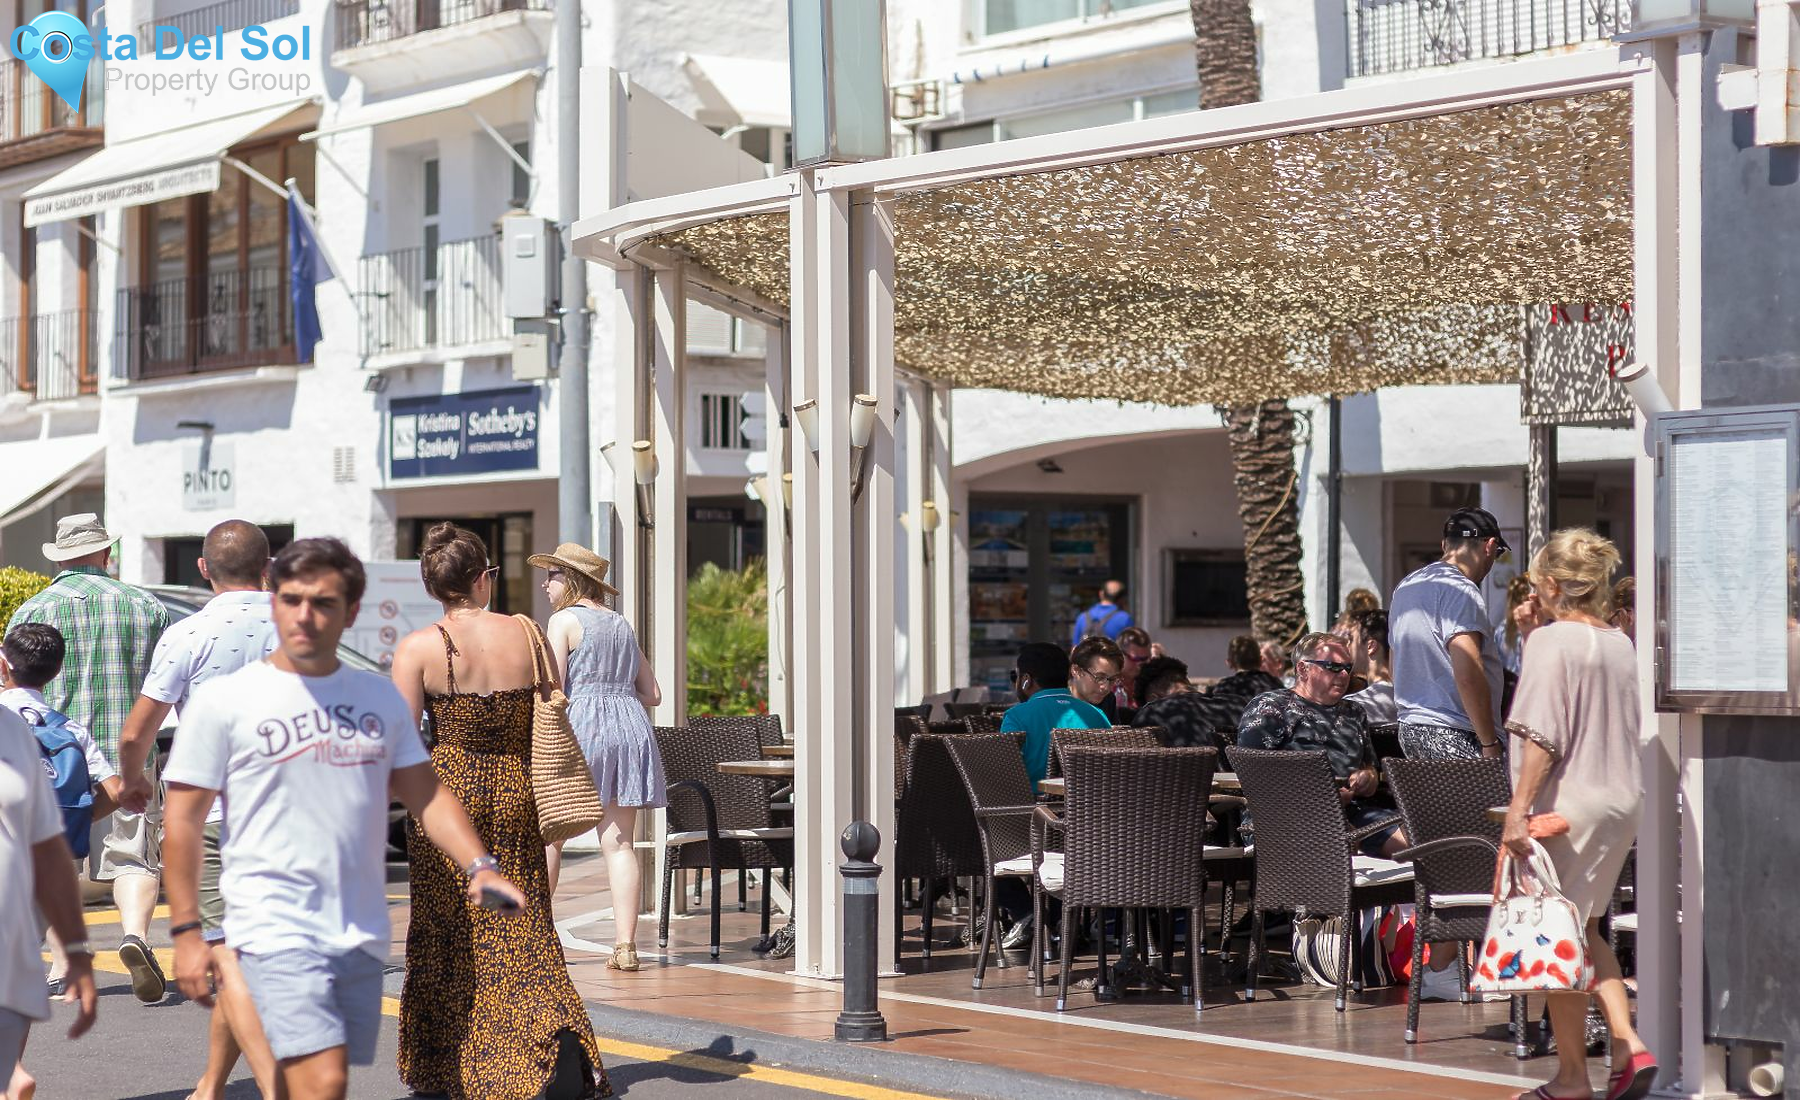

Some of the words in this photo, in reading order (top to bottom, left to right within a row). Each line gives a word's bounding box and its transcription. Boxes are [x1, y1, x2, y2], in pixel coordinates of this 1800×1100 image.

[418, 412, 461, 433] Kristina
[468, 406, 536, 437] Sotheby's
[183, 469, 231, 495] PINTO
